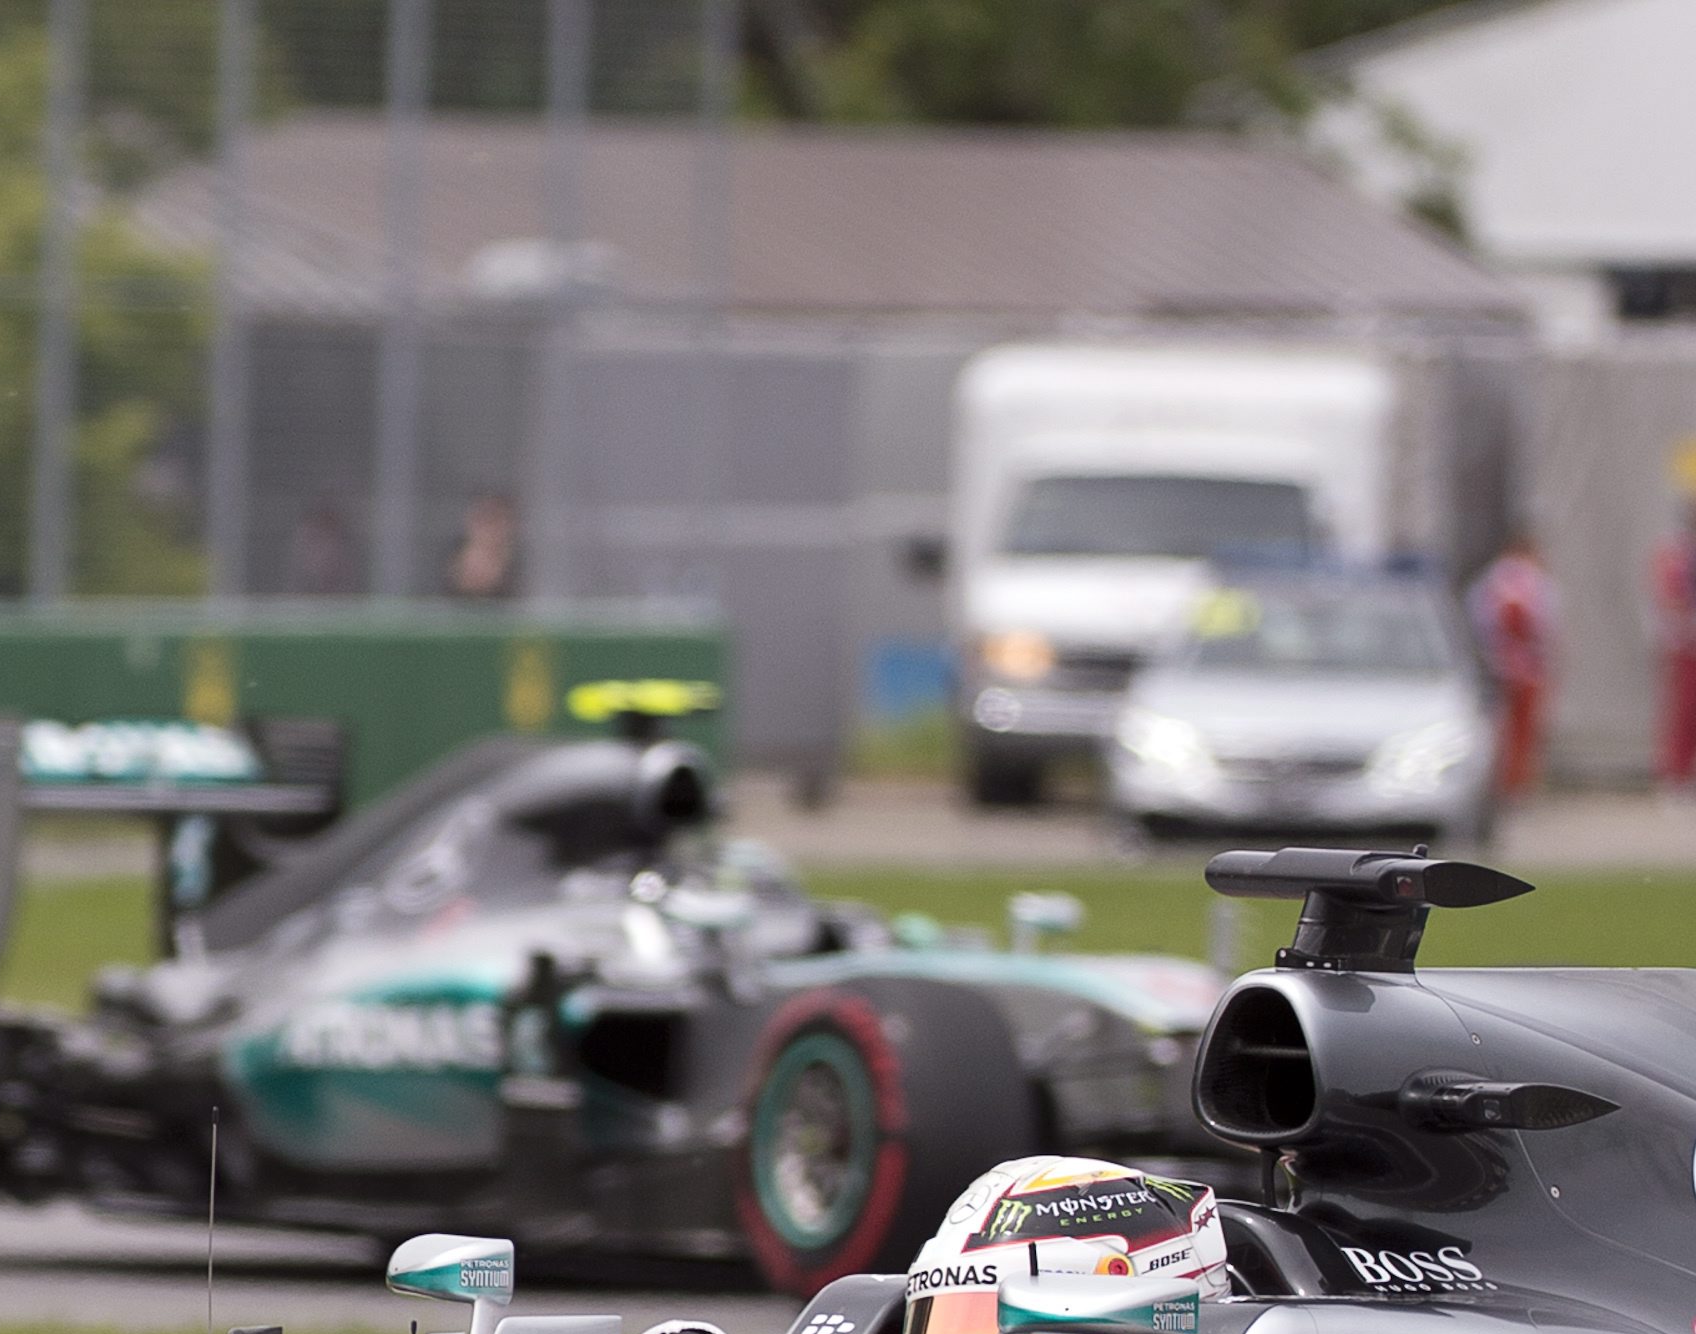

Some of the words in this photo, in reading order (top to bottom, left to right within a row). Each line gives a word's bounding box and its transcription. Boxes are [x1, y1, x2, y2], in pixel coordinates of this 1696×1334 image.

[1035, 1189, 1156, 1218] MONSTER
[1059, 1207, 1144, 1227] ENERGY
[1141, 1247, 1194, 1275] BOSE
[1339, 1246, 1484, 1284] BOSS
